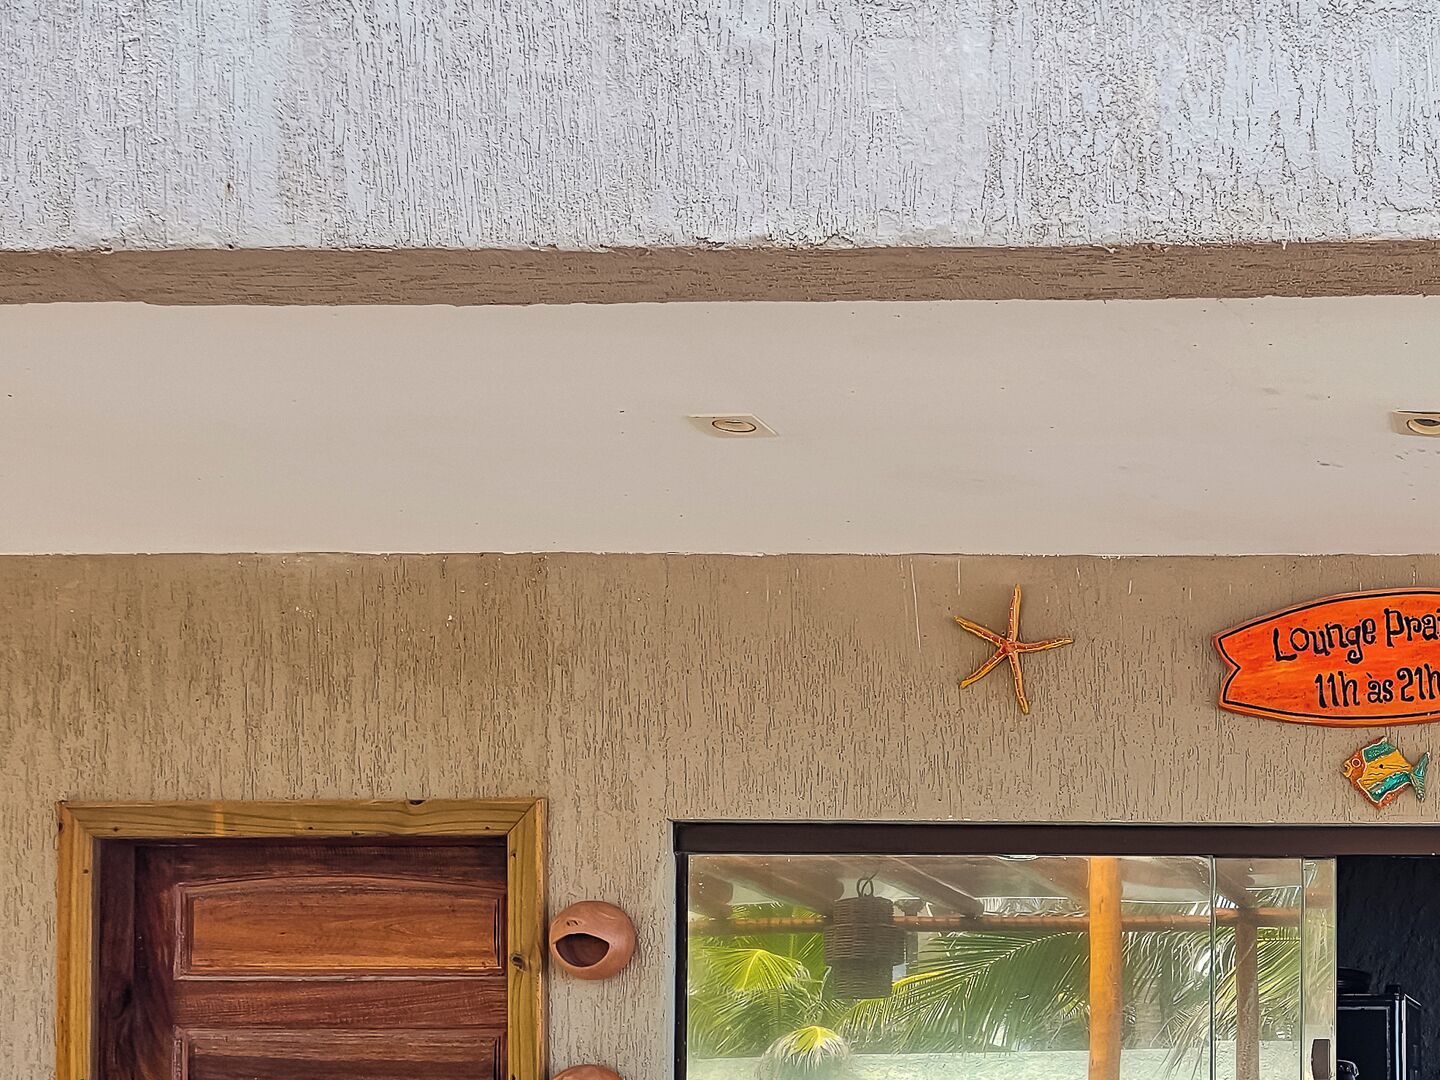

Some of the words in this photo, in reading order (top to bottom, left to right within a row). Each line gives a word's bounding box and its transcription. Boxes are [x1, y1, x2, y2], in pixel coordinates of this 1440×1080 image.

[1273, 617, 1376, 664] Lounge
[1314, 670, 1360, 708] 11h
[1366, 672, 1394, 703] às
